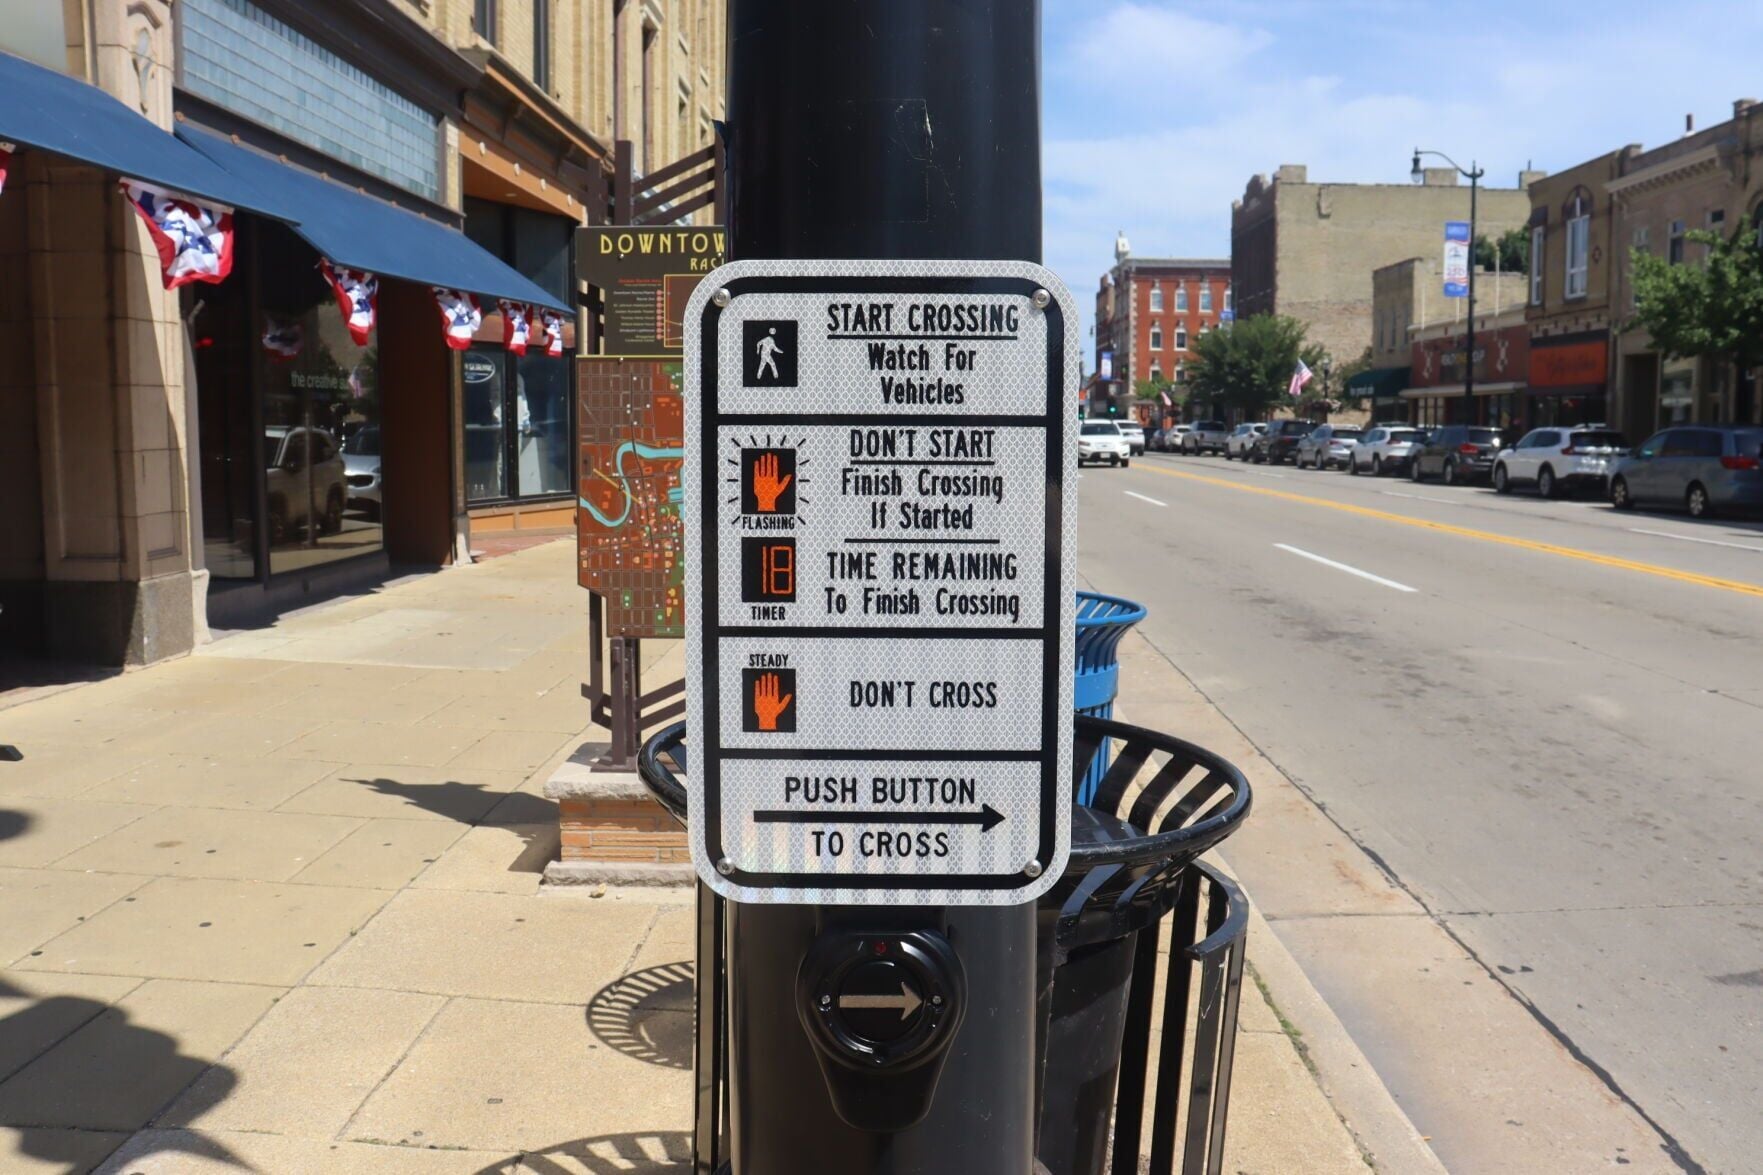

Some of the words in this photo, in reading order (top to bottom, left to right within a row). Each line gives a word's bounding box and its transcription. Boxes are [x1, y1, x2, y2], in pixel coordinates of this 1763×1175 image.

[828, 304, 893, 331] START
[909, 304, 1018, 332] CROSSING
[868, 343, 929, 370] Watch
[946, 343, 976, 370] For
[881, 377, 963, 404] Vehicles
[851, 430, 916, 457] DON'T
[930, 430, 995, 457] START
[843, 468, 902, 495] Finish
[918, 469, 1002, 503] Crossing
[743, 517, 794, 529] FLASHING
[872, 502, 886, 529] If
[900, 502, 972, 529] Started
[763, 546, 793, 594] 18
[827, 552, 876, 579] TIME
[893, 553, 1016, 580] REMAINING
[752, 607, 785, 620] TIMER
[825, 587, 846, 614] To
[864, 588, 919, 614] Finish
[936, 588, 1019, 623] Crossing
[750, 654, 788, 666] STEADY
[851, 681, 915, 707] DON'T
[930, 682, 996, 708] CROSS
[786, 777, 856, 803] PUSH
[873, 778, 974, 804] BUTTON
[812, 831, 843, 856] TO
[860, 832, 948, 857] CROSS
